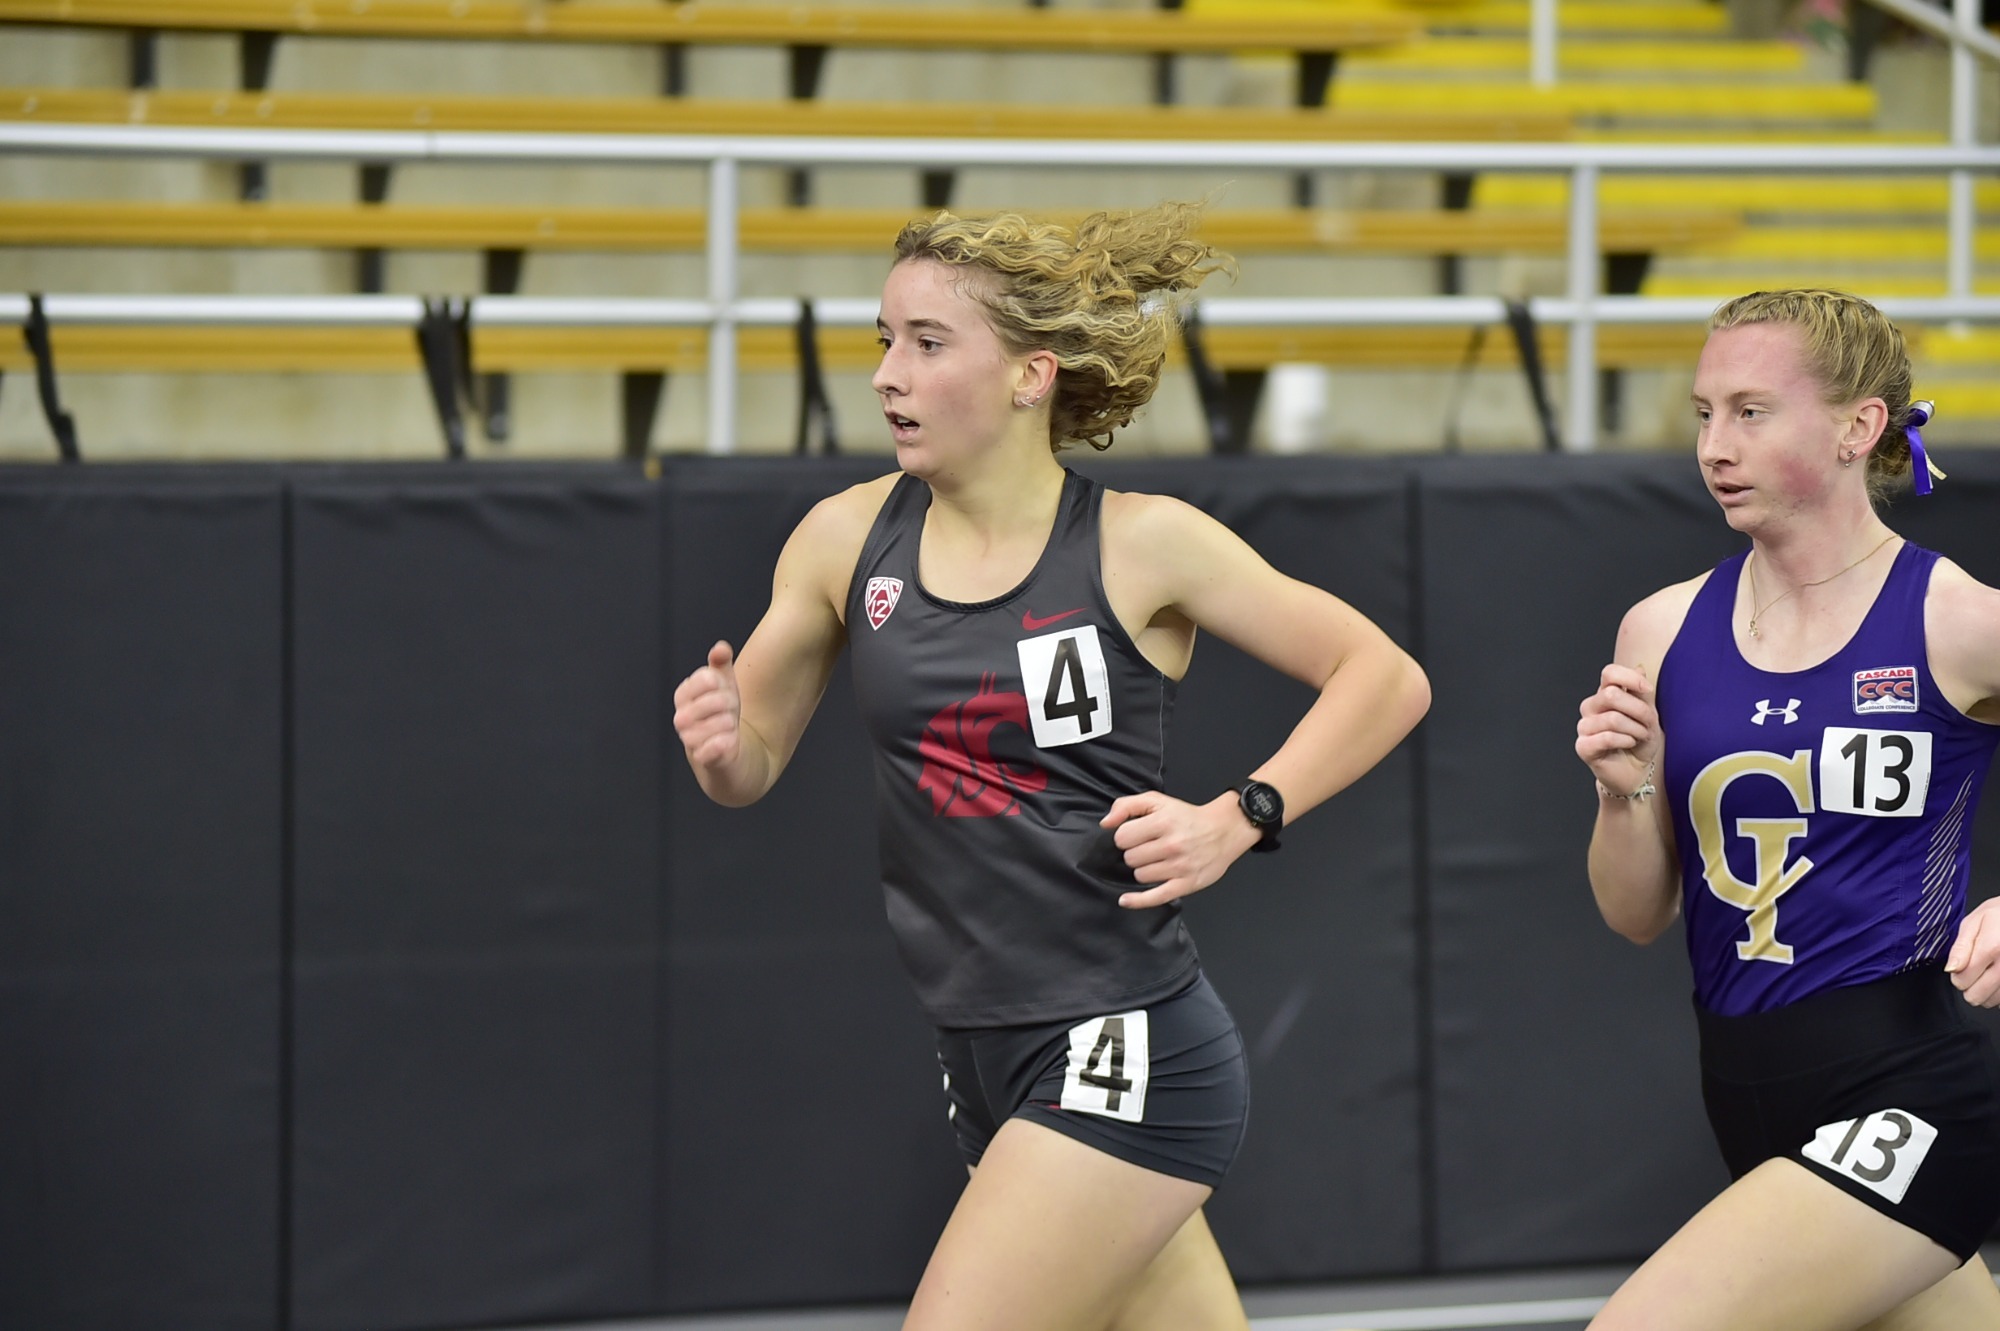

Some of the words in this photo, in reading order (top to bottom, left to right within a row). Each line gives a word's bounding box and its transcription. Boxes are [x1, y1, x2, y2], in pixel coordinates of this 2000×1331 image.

[868, 579, 901, 608] PAC
[870, 599, 889, 618] 12
[1043, 637, 1098, 735] 4
[1856, 669, 1913, 680] CASCADE
[1858, 681, 1913, 699] CCC
[1840, 733, 1914, 812] 13
[1078, 1017, 1133, 1112] 4
[1830, 1111, 1913, 1183] 13
